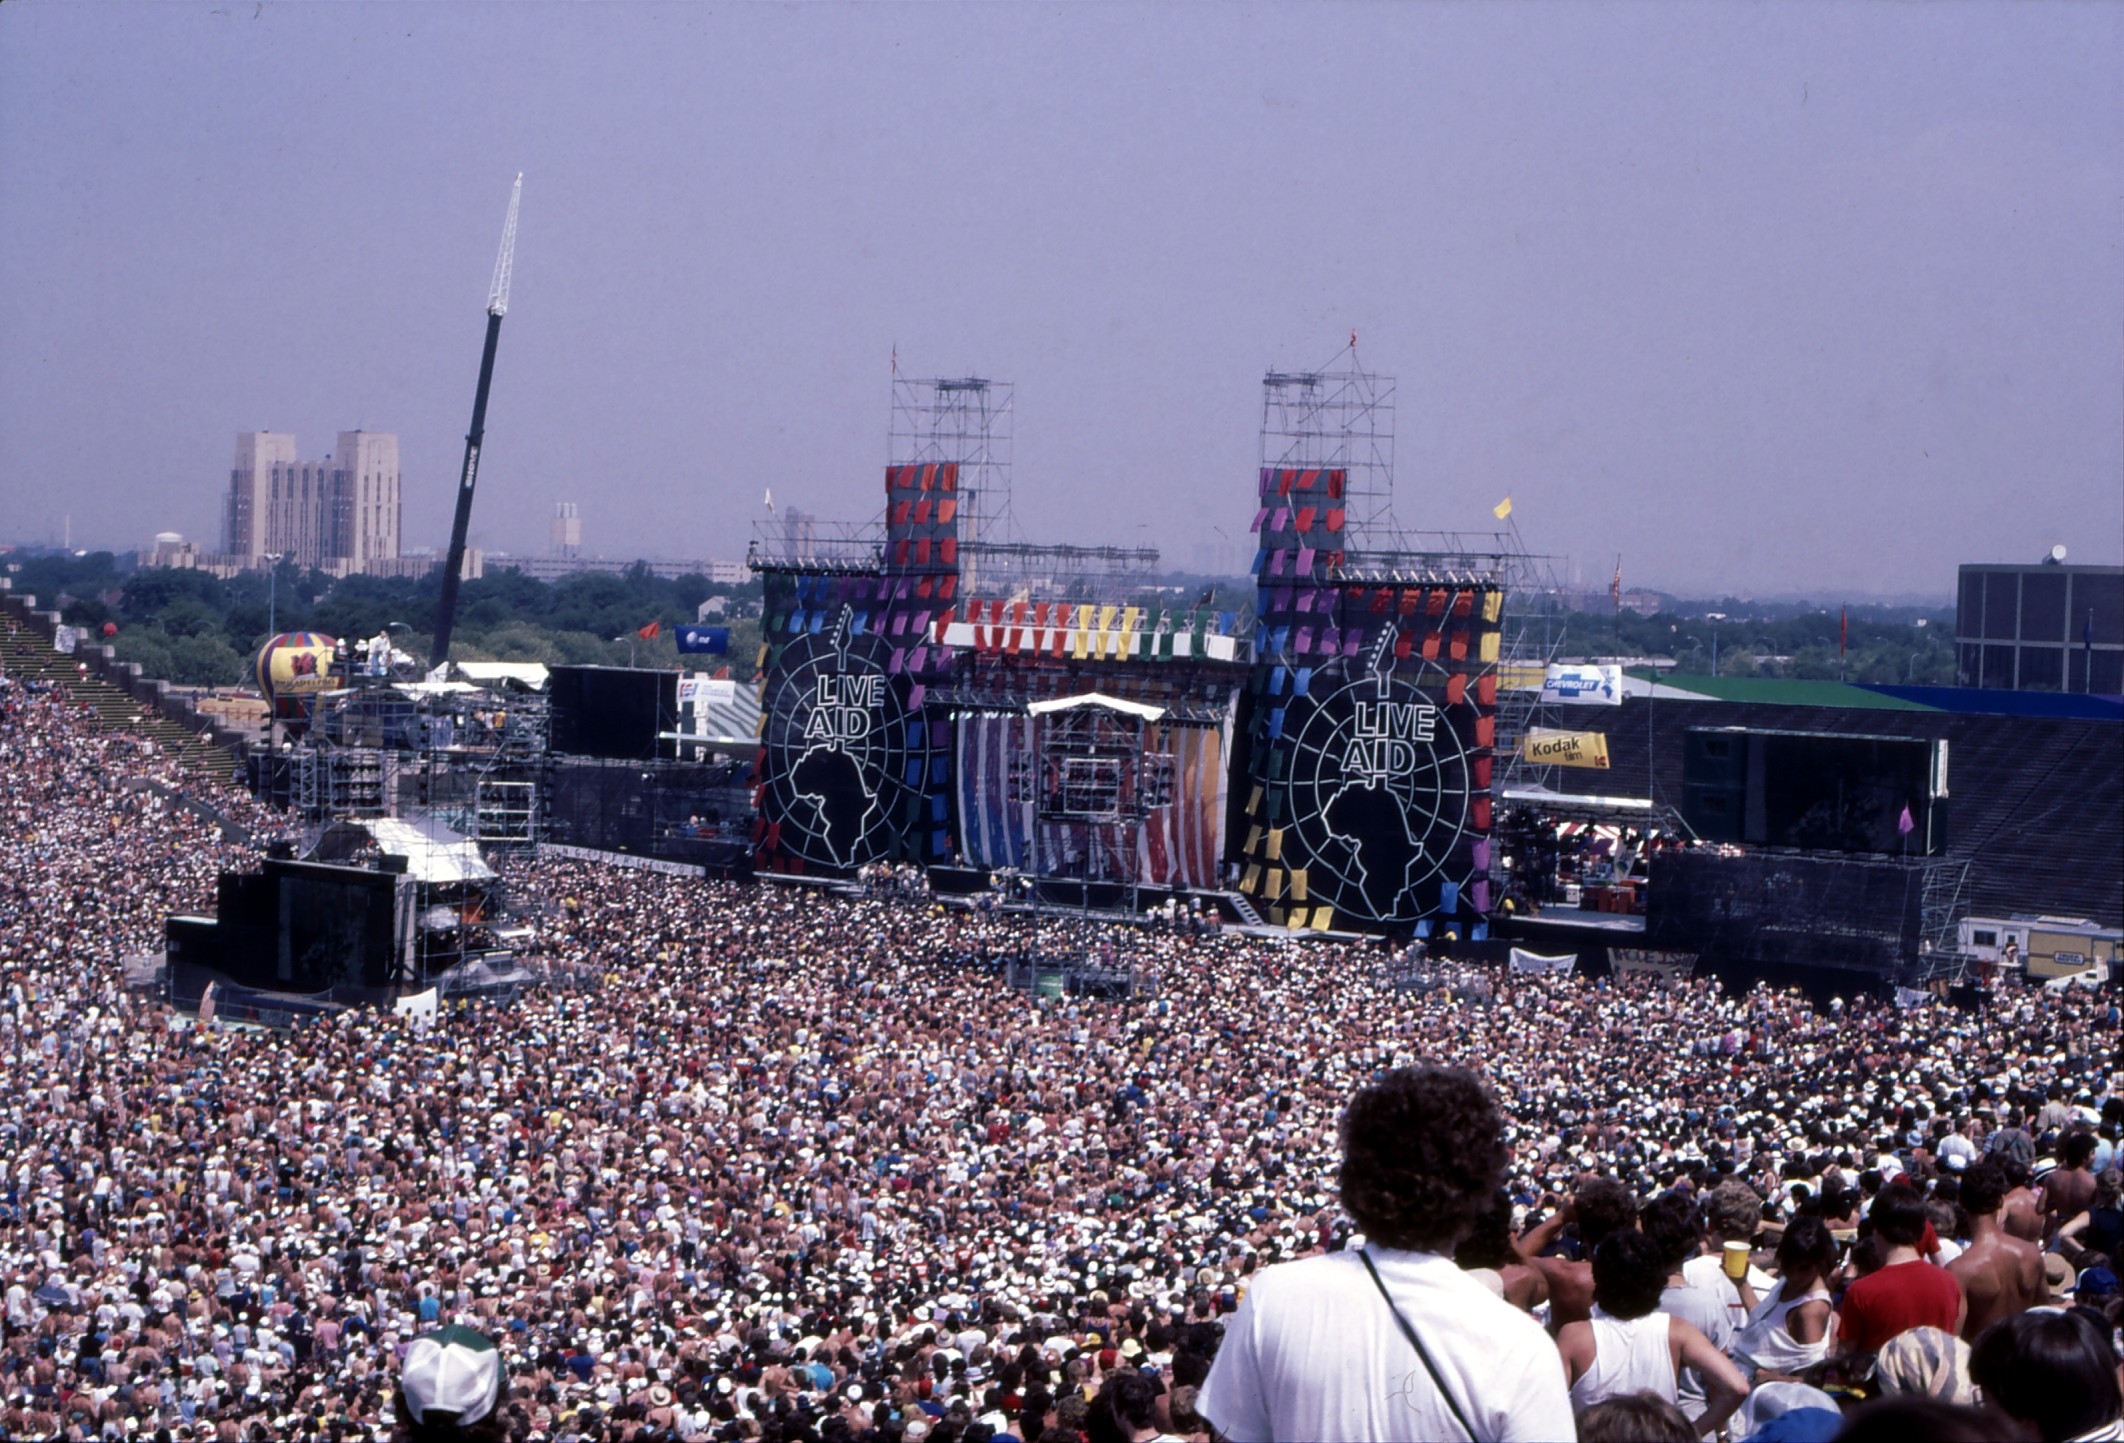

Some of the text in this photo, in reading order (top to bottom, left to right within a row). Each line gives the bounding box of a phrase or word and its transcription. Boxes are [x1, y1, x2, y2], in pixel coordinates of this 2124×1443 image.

[818, 674, 885, 707] LIVE
[1546, 680, 1596, 690] CHEVROLET
[803, 706, 871, 739] AID
[1355, 701, 1436, 741] LIVE
[1340, 738, 1416, 776] AID
[1532, 737, 1580, 756] Kodak
[1564, 750, 1583, 762] film
